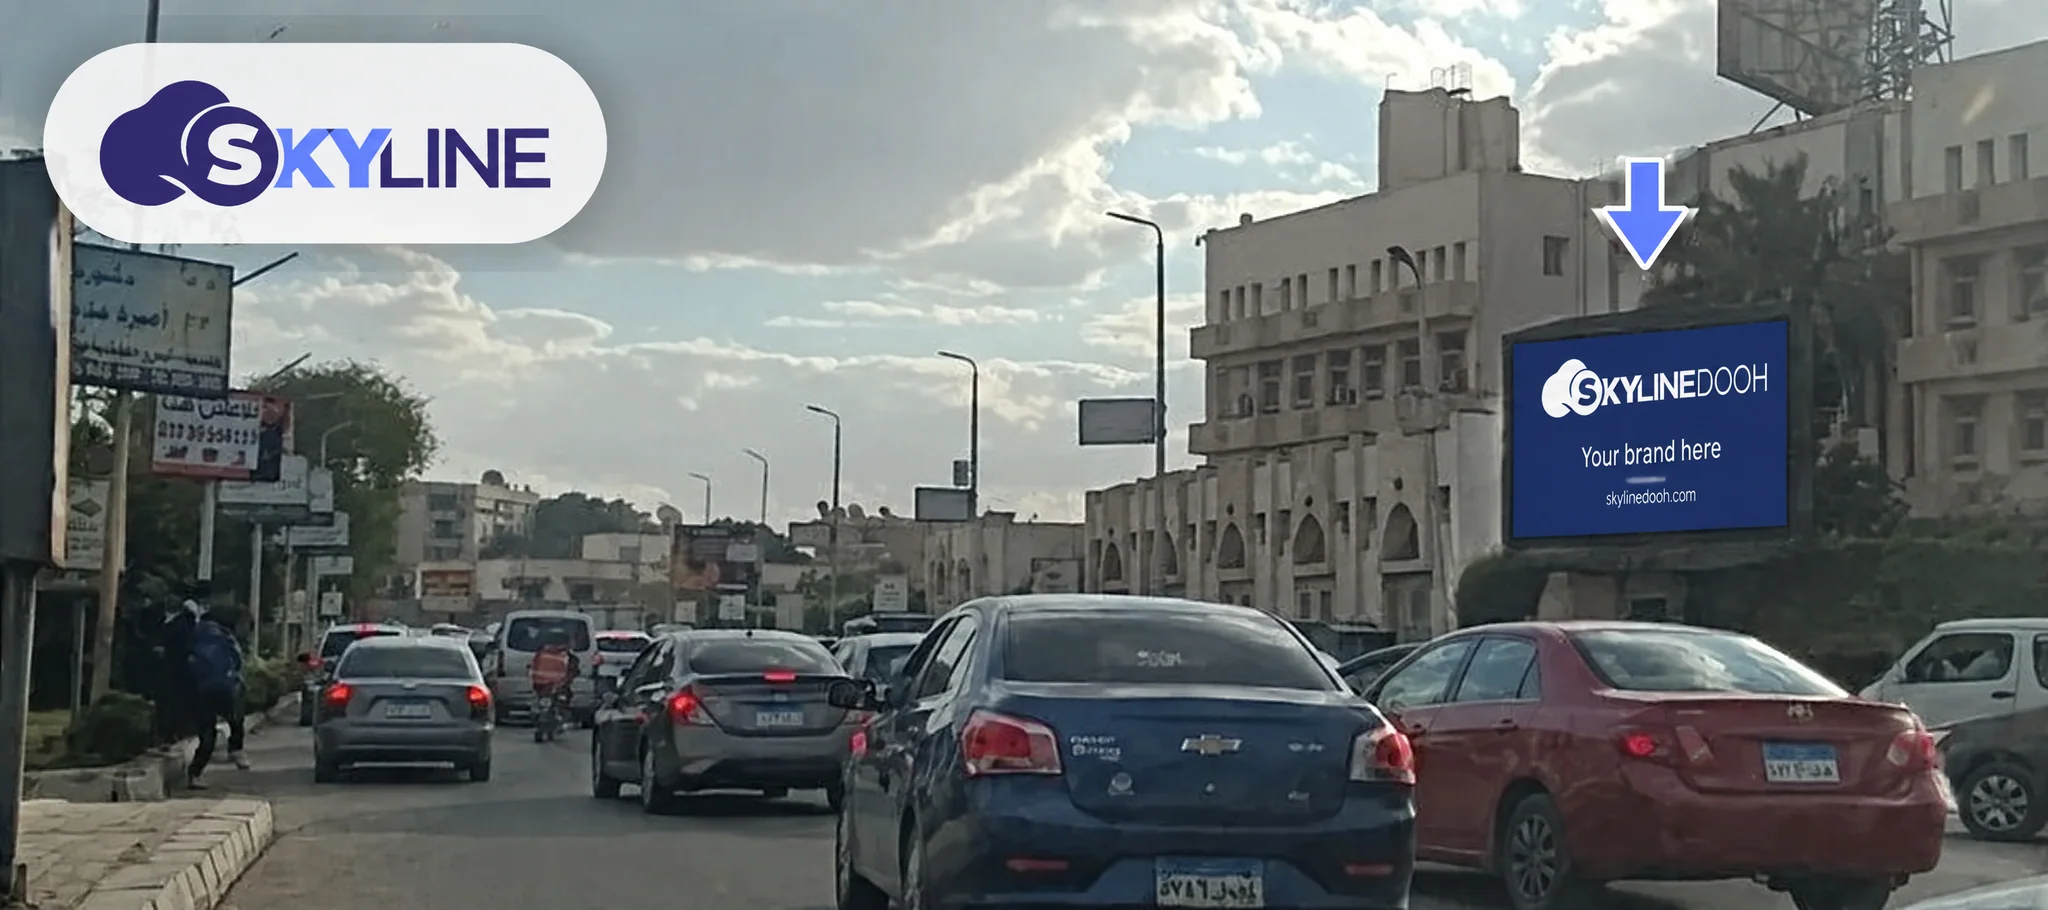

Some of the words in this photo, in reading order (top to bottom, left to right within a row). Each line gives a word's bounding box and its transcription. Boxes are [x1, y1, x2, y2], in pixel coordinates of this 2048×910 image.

[1577, 363, 1768, 406] SKYLINEDOOH
[1582, 446, 1620, 468] Your
[1624, 439, 1675, 465] brand
[1681, 438, 1721, 461] here
[1606, 488, 1696, 508] skylinedooh.com
